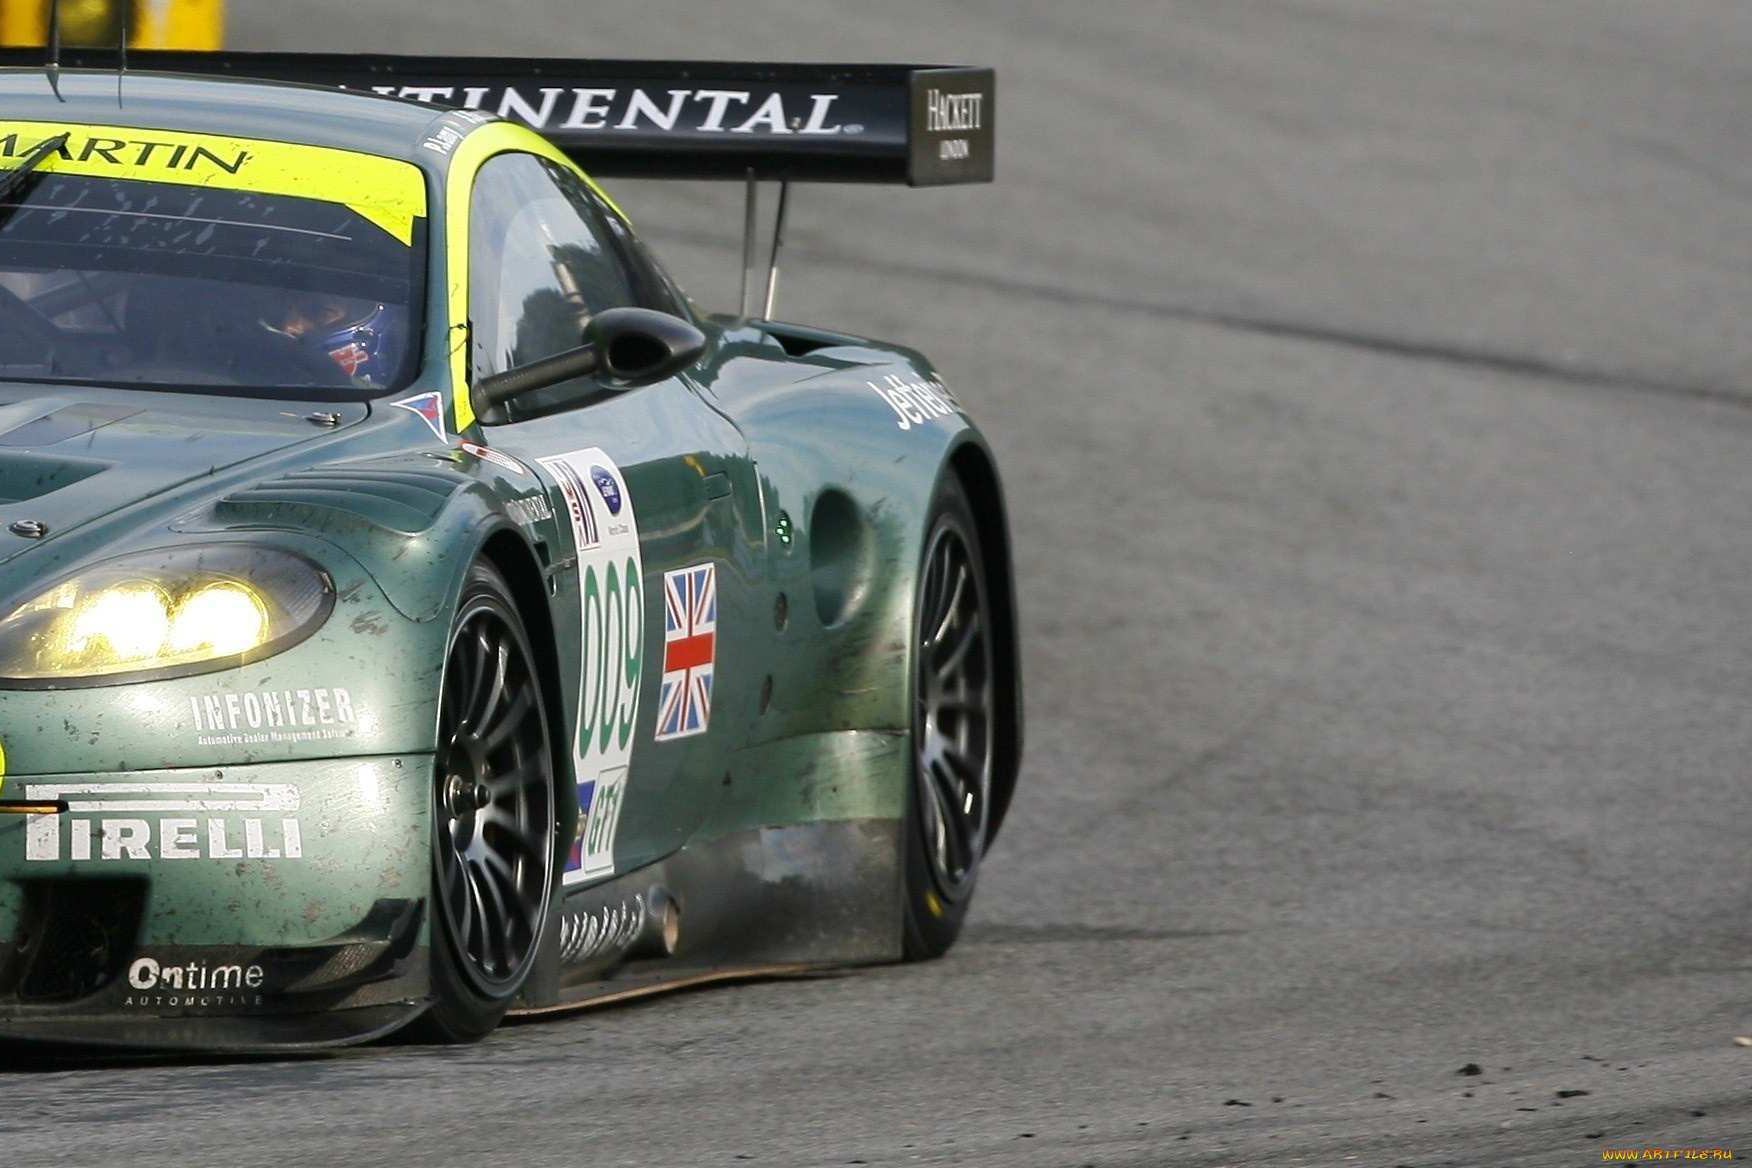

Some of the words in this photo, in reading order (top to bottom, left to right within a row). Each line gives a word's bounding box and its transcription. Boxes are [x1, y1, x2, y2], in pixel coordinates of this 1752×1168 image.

[579, 555, 644, 760] 009
[190, 687, 358, 732] INFONIZER
[25, 782, 303, 861] PIRELLI
[128, 957, 264, 990] Ontime
